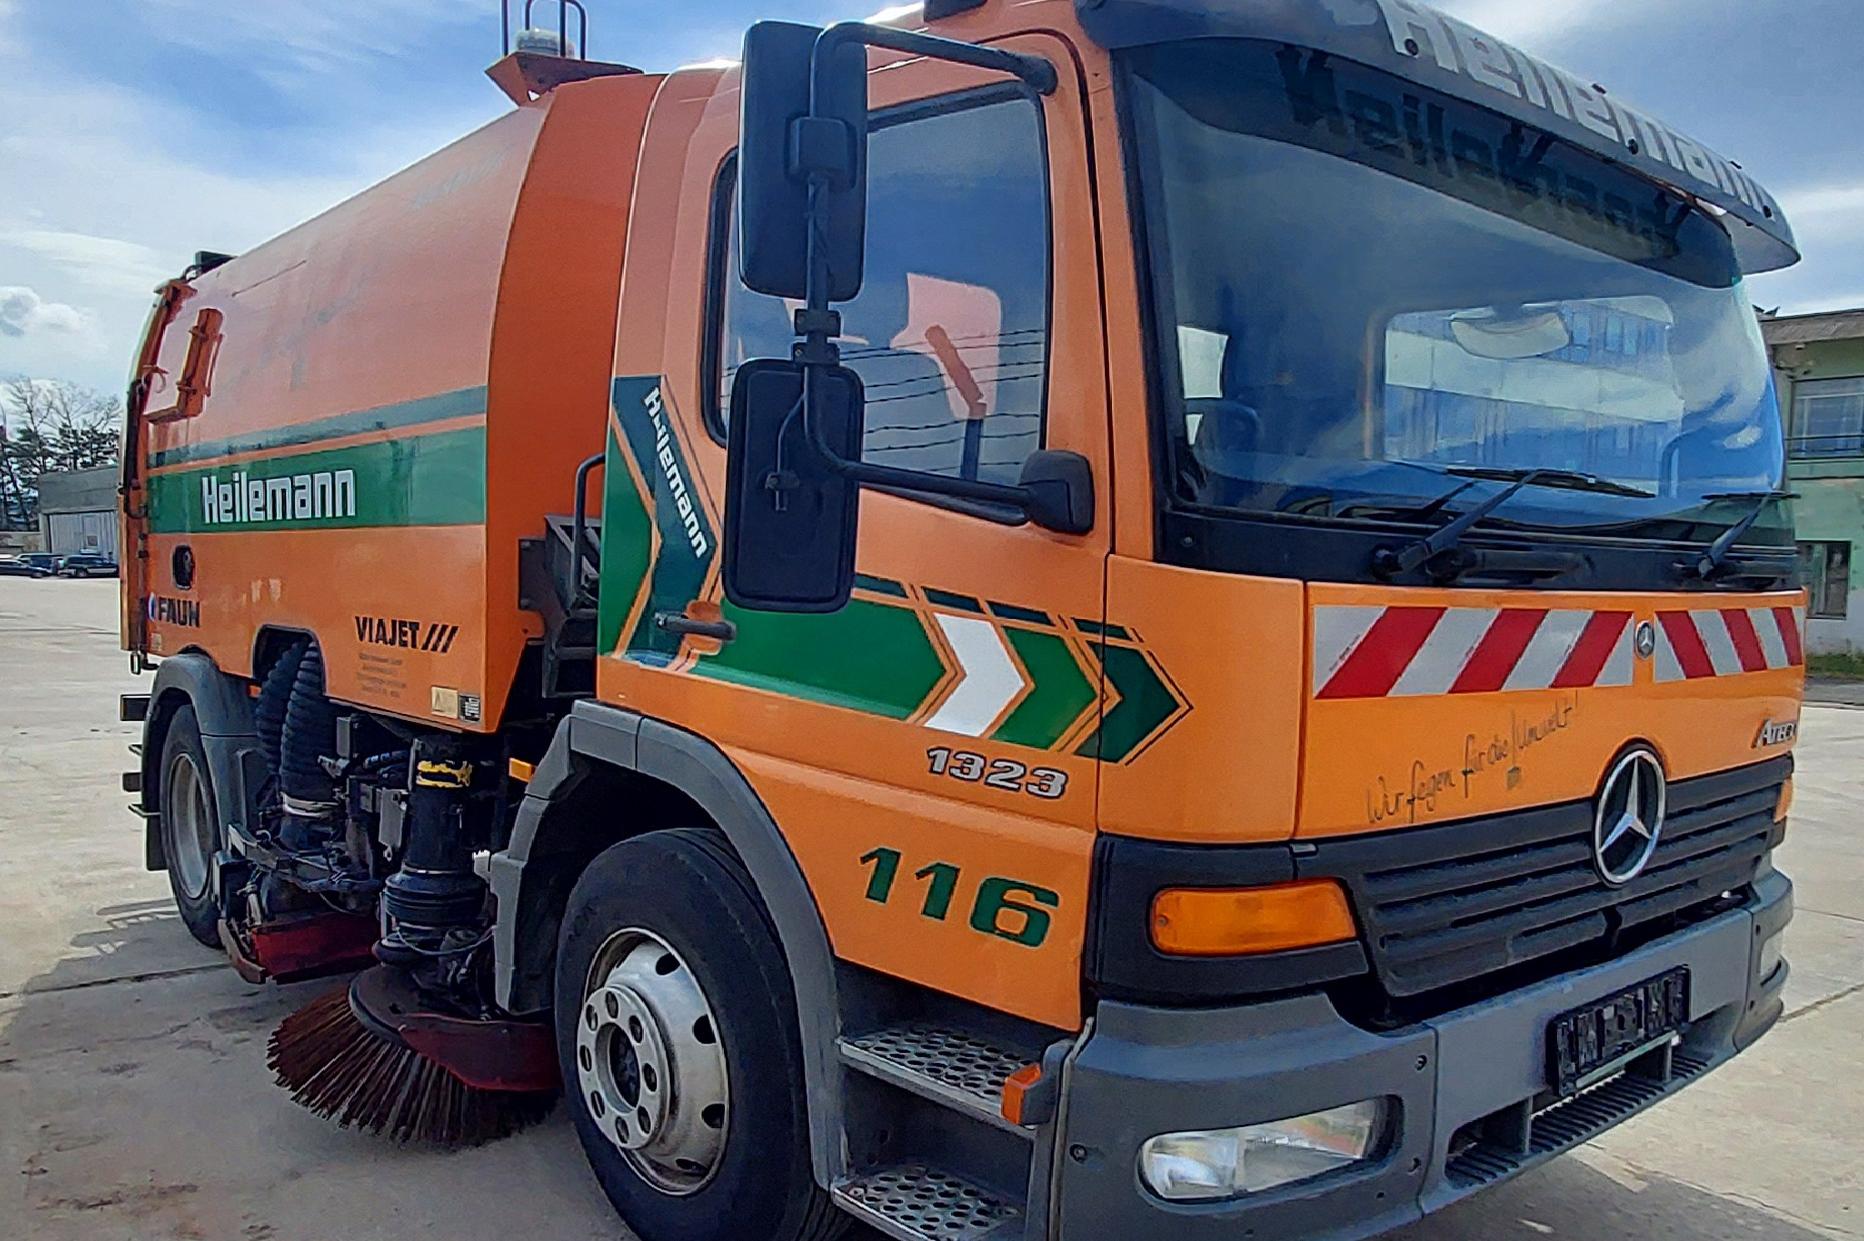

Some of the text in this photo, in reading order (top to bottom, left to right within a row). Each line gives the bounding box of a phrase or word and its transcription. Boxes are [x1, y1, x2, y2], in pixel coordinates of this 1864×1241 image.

[201, 469, 357, 524] Heilemann
[354, 615, 420, 649] VIAJET
[926, 746, 1069, 800] 1323
[859, 846, 1062, 949] 116
